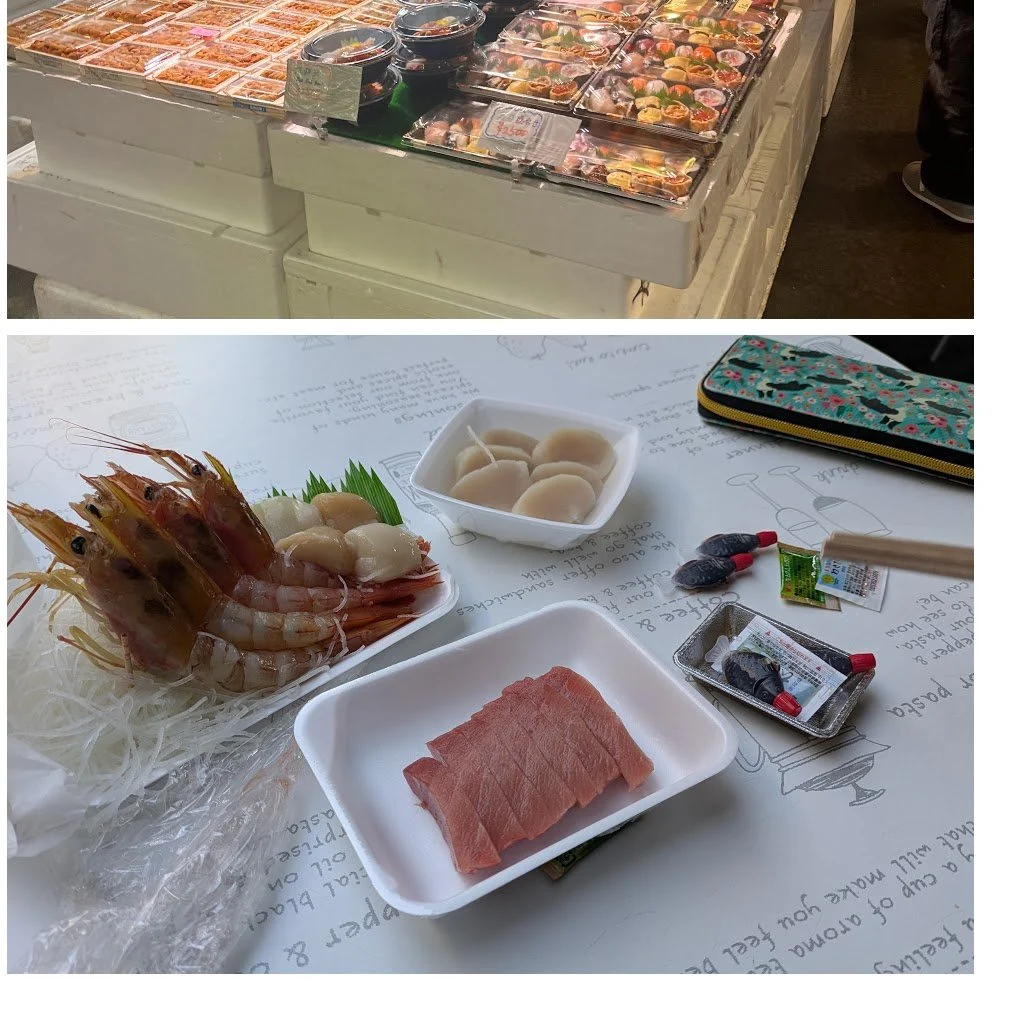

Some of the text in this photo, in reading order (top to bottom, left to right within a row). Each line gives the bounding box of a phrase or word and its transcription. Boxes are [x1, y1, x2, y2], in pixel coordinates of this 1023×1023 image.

[394, 402, 463, 424] sonings
[601, 521, 652, 539] coffee
[520, 530, 666, 581] that go well with
[456, 540, 677, 616] We also offer sandwiches
[600, 587, 613, 597] &
[940, 580, 969, 596] can
[625, 590, 654, 605] our
[635, 618, 657, 633] &
[884, 600, 972, 638] to see how
[950, 608, 974, 632] our
[912, 654, 928, 666] &
[885, 677, 953, 718] pasta
[286, 808, 335, 835] asta
[268, 851, 346, 891] oil on
[890, 844, 931, 874] will
[941, 860, 958, 873] a
[823, 867, 886, 905] make
[896, 874, 937, 898] cup
[248, 890, 314, 931] blac
[776, 893, 821, 930] you
[867, 897, 894, 926] of
[282, 897, 400, 968] pper &
[722, 924, 775, 965] feel
[787, 913, 862, 958] aroma
